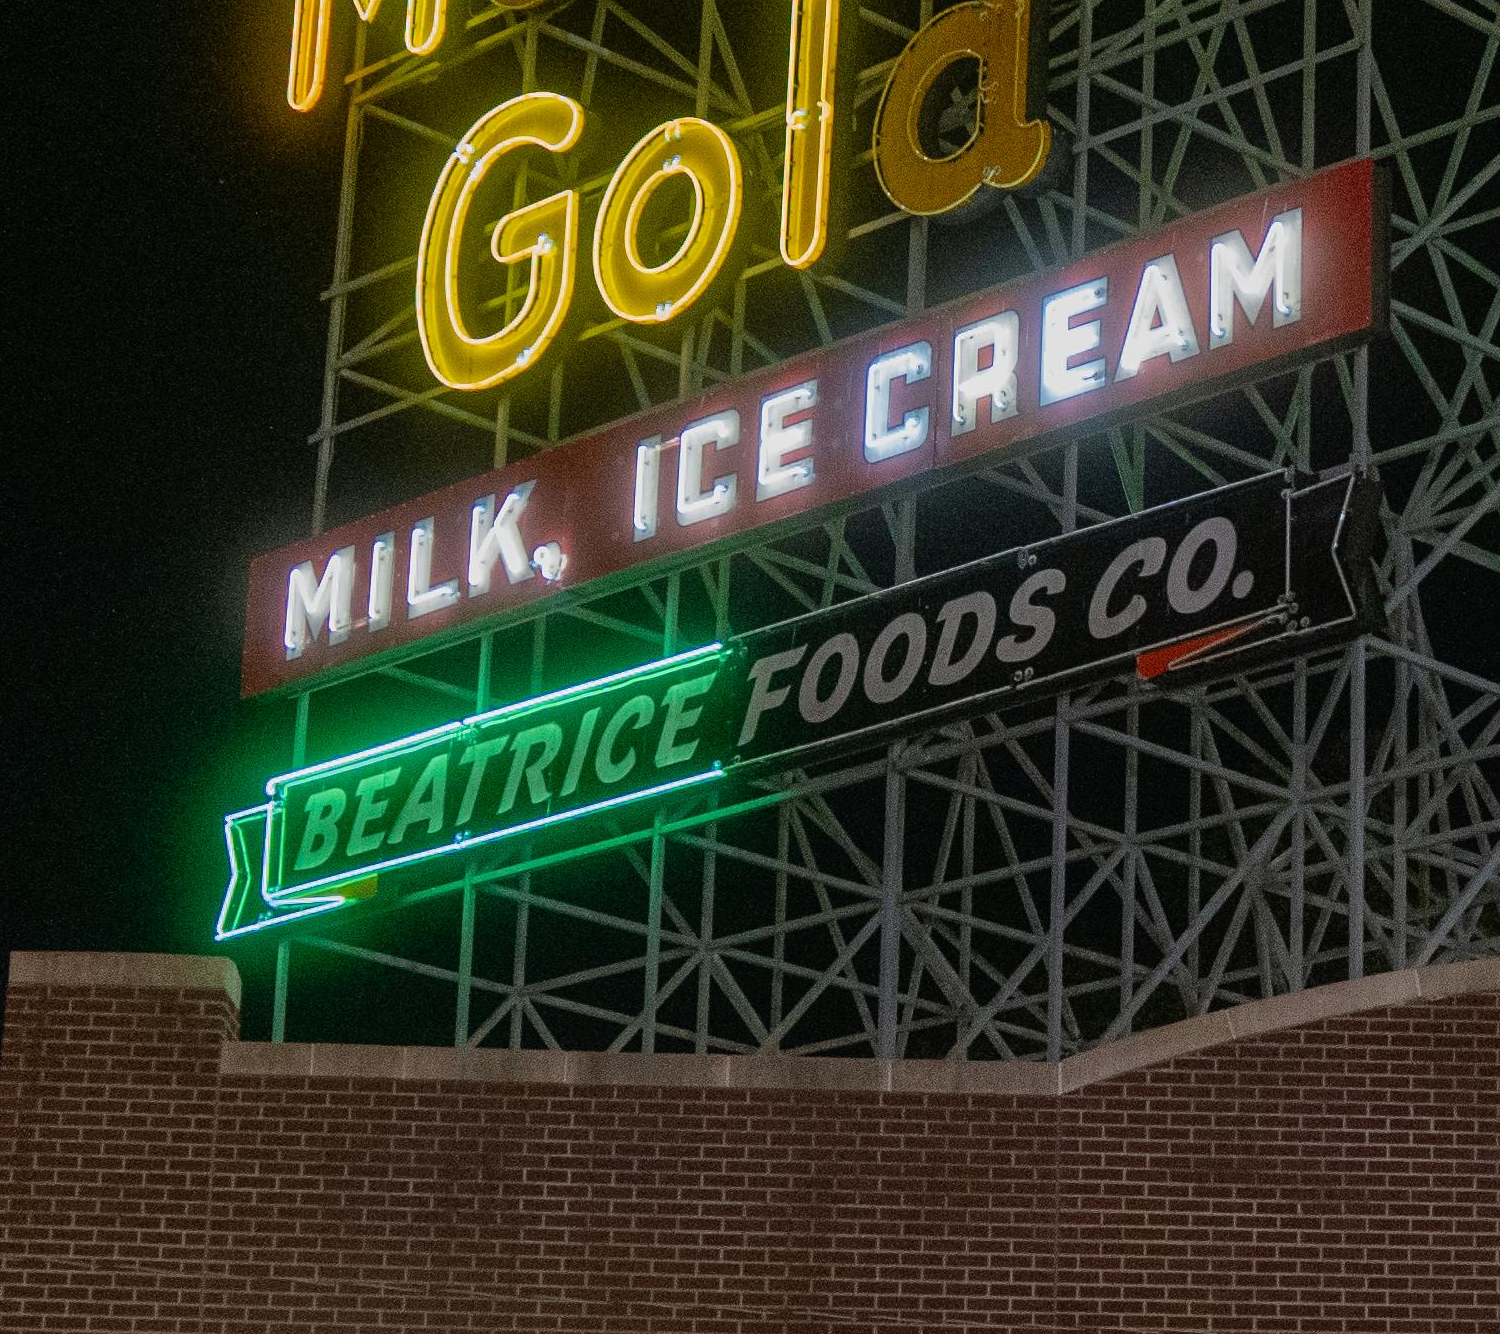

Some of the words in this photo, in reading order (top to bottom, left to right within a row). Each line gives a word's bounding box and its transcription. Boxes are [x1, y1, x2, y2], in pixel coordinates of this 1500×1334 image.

[284, 481, 568, 660] MILK,
[632, 379, 820, 544] ICE
[863, 207, 1304, 465] CREAM
[295, 667, 720, 872] BEATRICE
[737, 569, 1069, 748] FOODS
[1088, 515, 1256, 641] CO.
